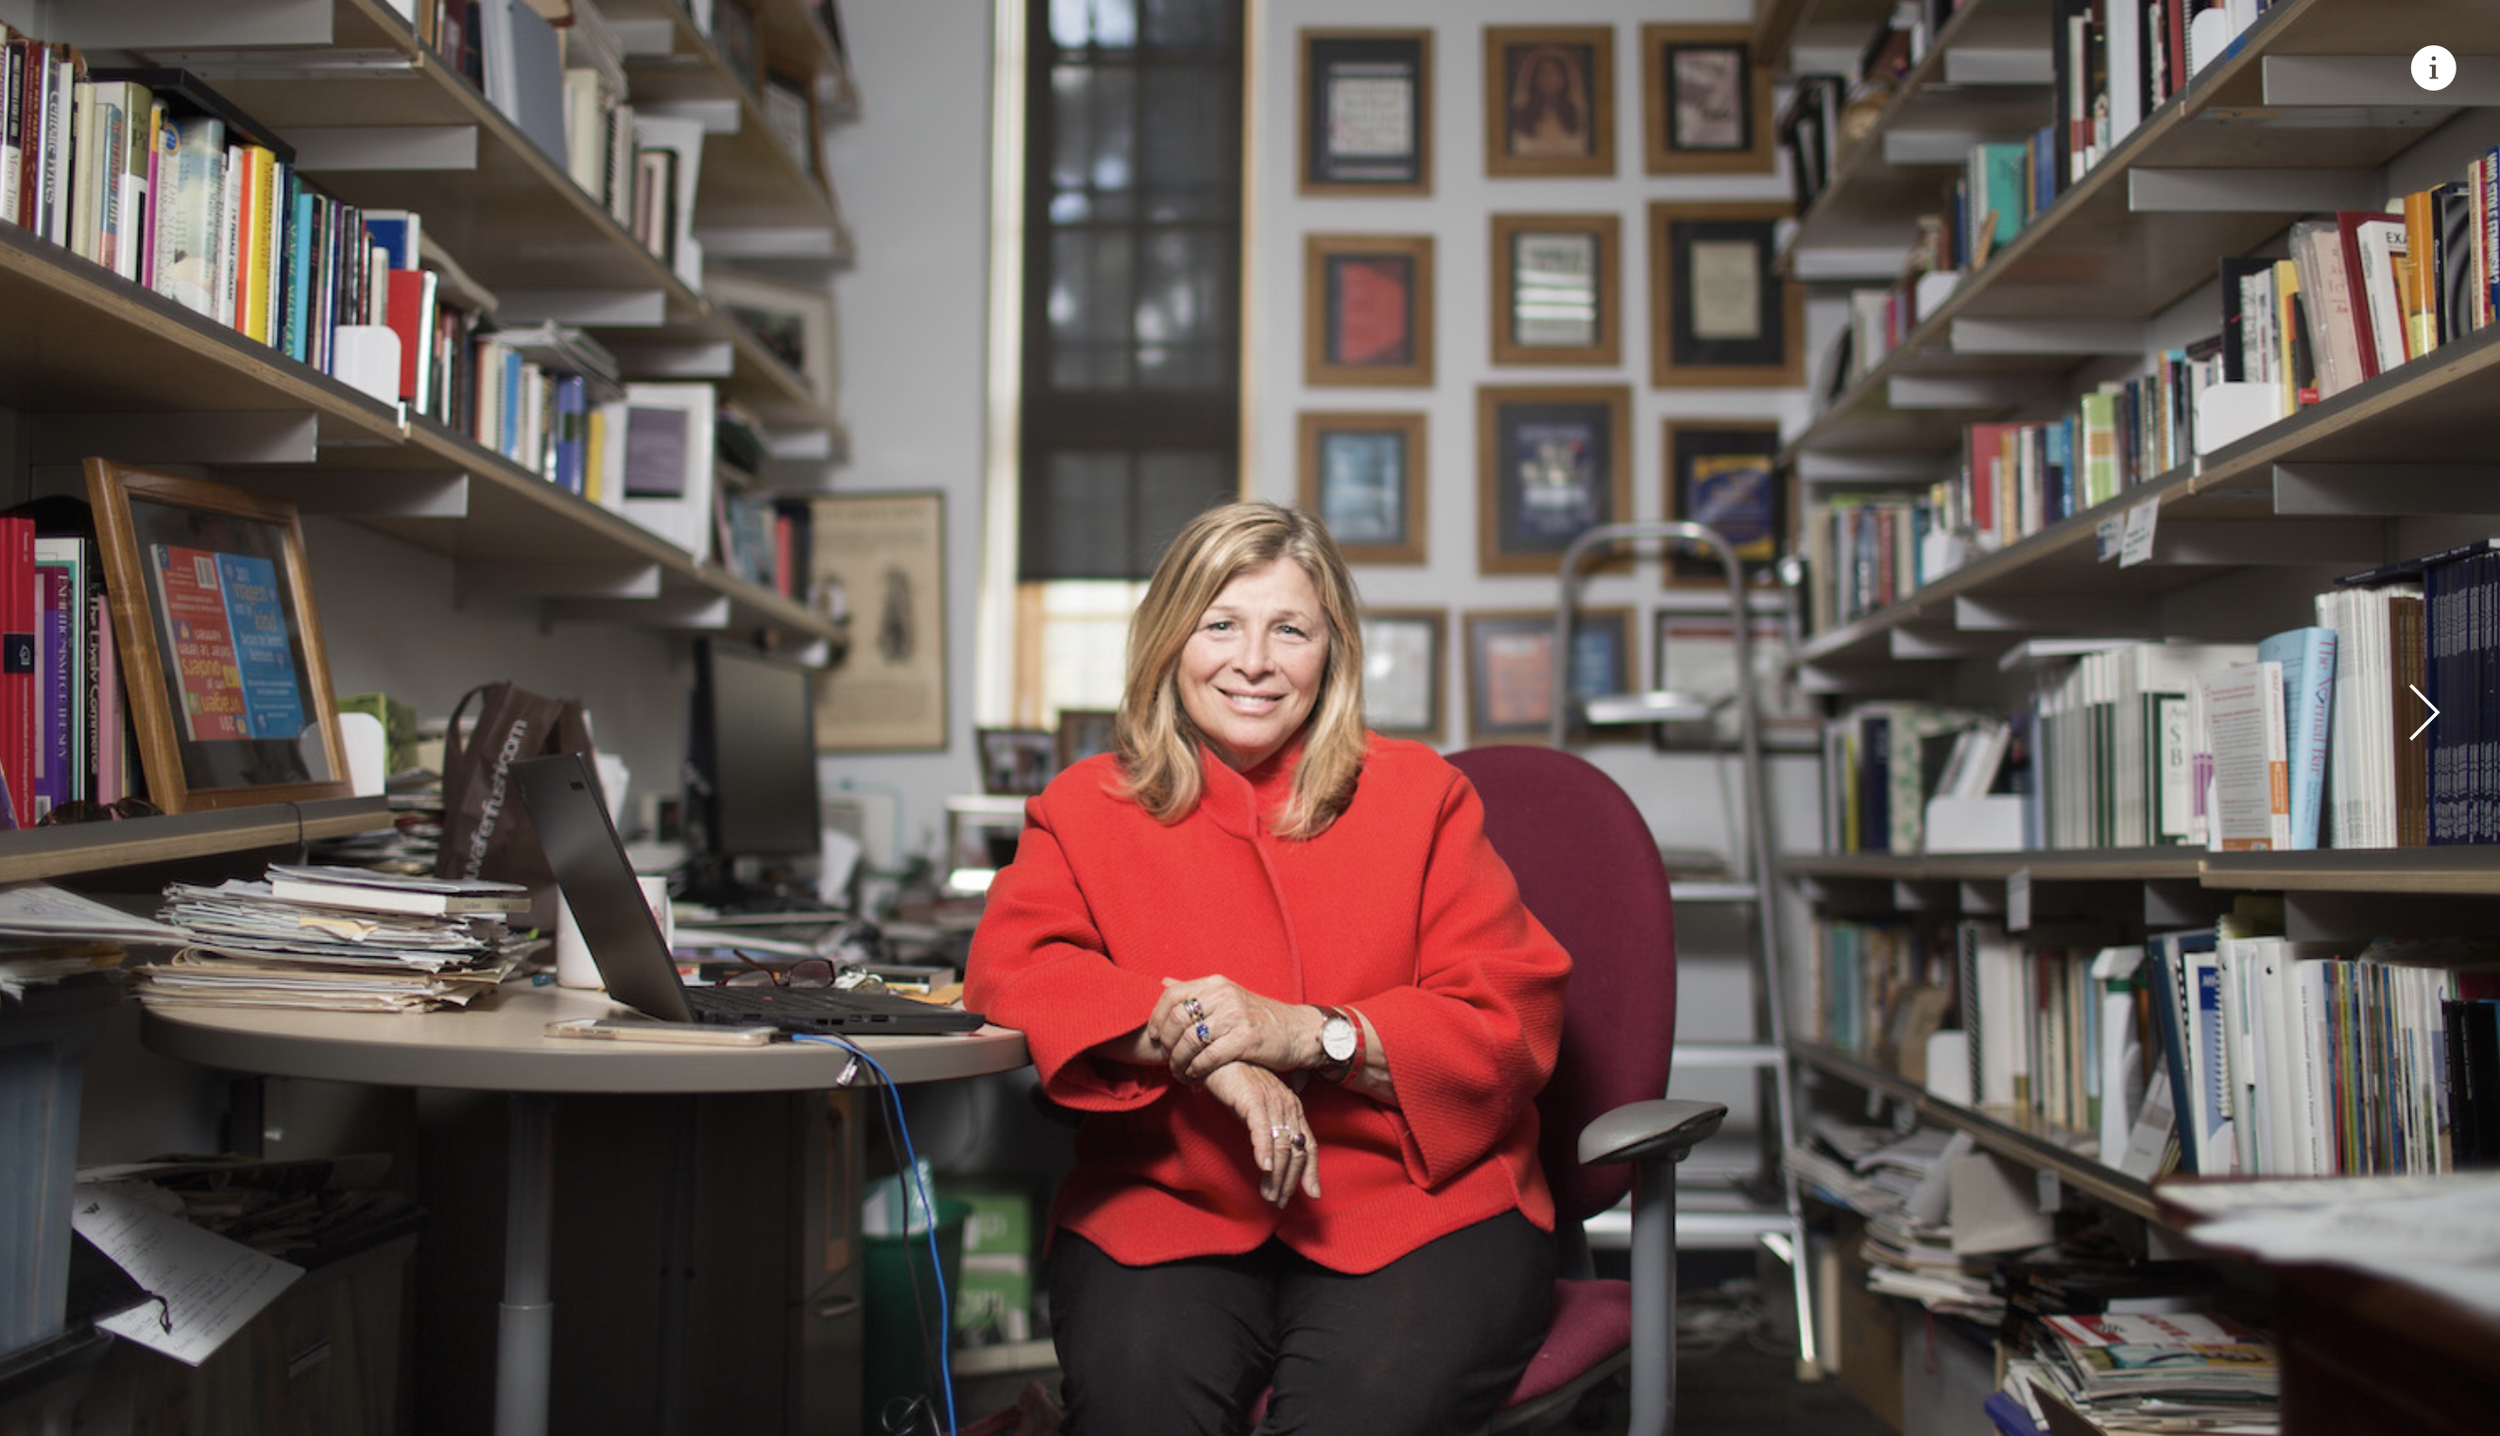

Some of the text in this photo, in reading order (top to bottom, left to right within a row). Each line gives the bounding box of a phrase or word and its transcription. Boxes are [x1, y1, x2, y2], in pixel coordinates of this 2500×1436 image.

[2486, 152, 2500, 284] WHO STOLE FEMINISM?
[228, 222, 237, 256] FEMALE
[228, 258, 236, 300] ORGASM
[58, 574, 69, 674] EXHIBITIONISM
[182, 659, 221, 678] ouders
[2318, 640, 2335, 670] The
[58, 676, 68, 702] FOR
[88, 595, 100, 774] The Lively Commerce
[202, 692, 242, 713] vragen
[58, 708, 67, 729] THE
[2310, 747, 2326, 776] Bar
